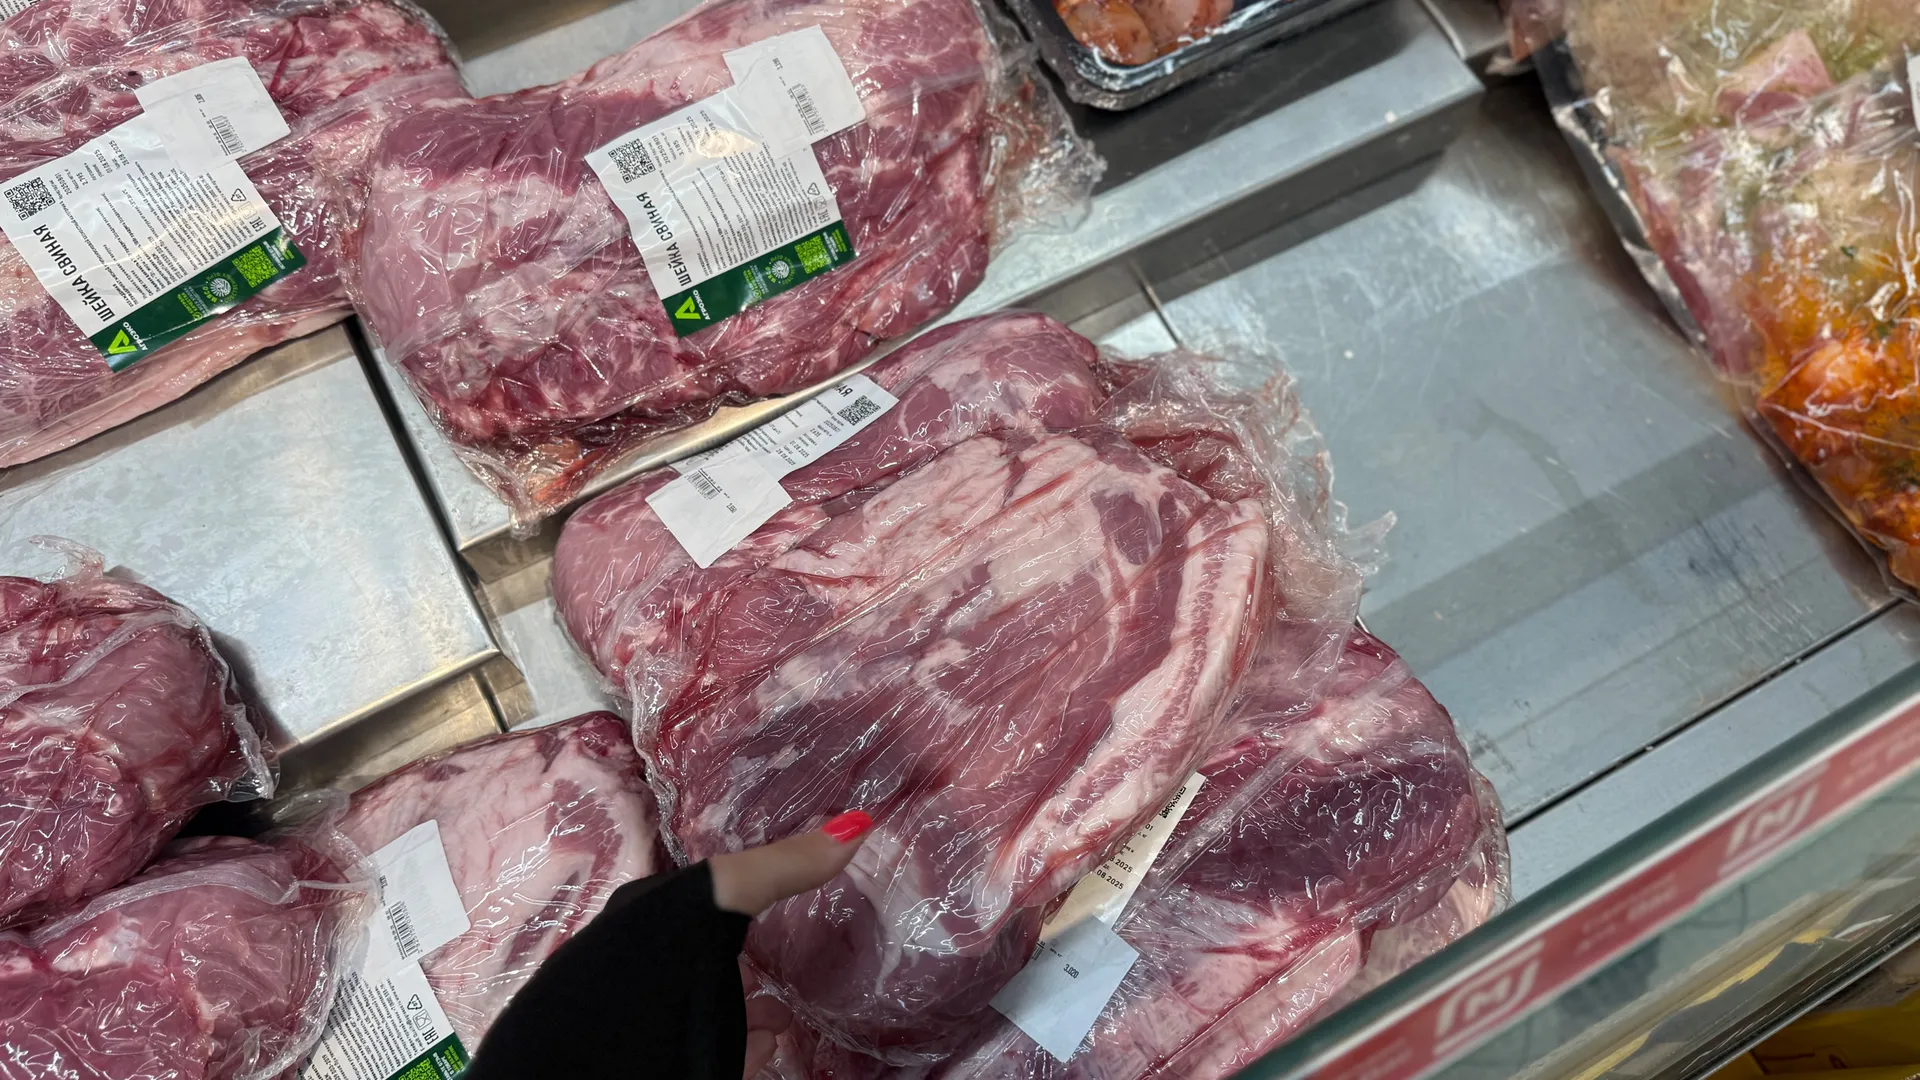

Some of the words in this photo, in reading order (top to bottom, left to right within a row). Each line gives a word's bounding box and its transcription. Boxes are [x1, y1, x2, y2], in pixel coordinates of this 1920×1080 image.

[636, 192, 672, 240] СВИНАЯ
[33, 224, 76, 275] СВИНАЯ
[666, 242, 691, 285] ШЕЙКА
[72, 275, 114, 321] ШЕЙКА
[692, 289, 710, 319] АГРОЭКО
[123, 321, 147, 350] АГРОЭКО
[1063, 963, 1079, 978] 3.020
